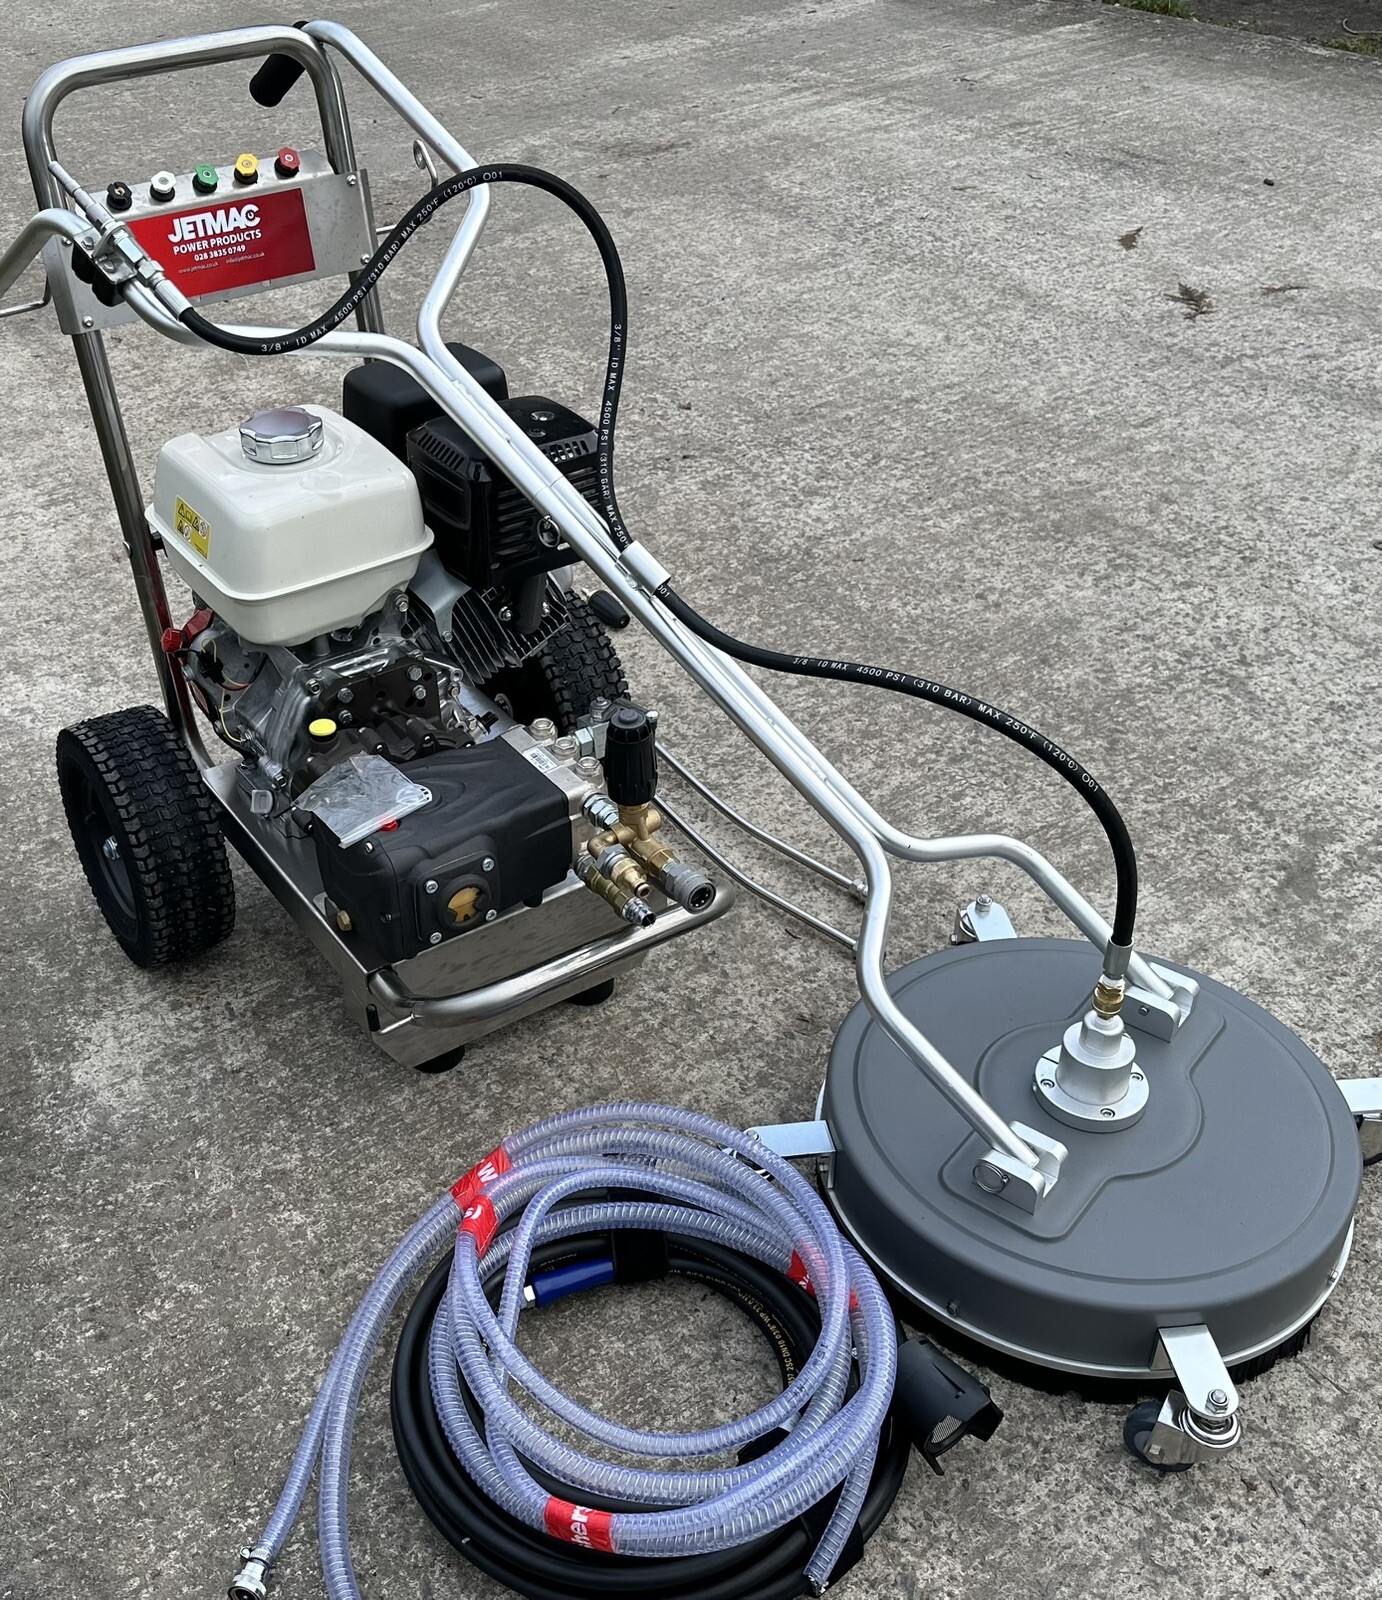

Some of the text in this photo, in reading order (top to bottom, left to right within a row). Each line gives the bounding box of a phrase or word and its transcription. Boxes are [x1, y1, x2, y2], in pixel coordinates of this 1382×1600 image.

[168, 204, 261, 243] JETMAC
[173, 229, 262, 256] POWER PRODUCTS
[194, 244, 246, 262] 028 3835 0749
[296, 334, 308, 347] ID
[310, 324, 329, 341] MAX
[332, 302, 354, 324] 4500
[352, 286, 368, 304] PSI
[367, 262, 385, 285] (310
[384, 240, 401, 262] BAR)
[401, 219, 417, 239] MAX
[611, 357, 620, 369] ID
[607, 372, 618, 392] MAX
[602, 400, 613, 426] 4500
[600, 428, 610, 448] PSI
[599, 452, 608, 477] (310
[606, 504, 618, 523] MAX
[830, 661, 849, 671] MAX
[856, 665, 883, 678] 4500
[885, 671, 906, 683] PSI
[912, 678, 940, 694] (310
[944, 689, 972, 706] BAR)
[978, 703, 1002, 720] MAX
